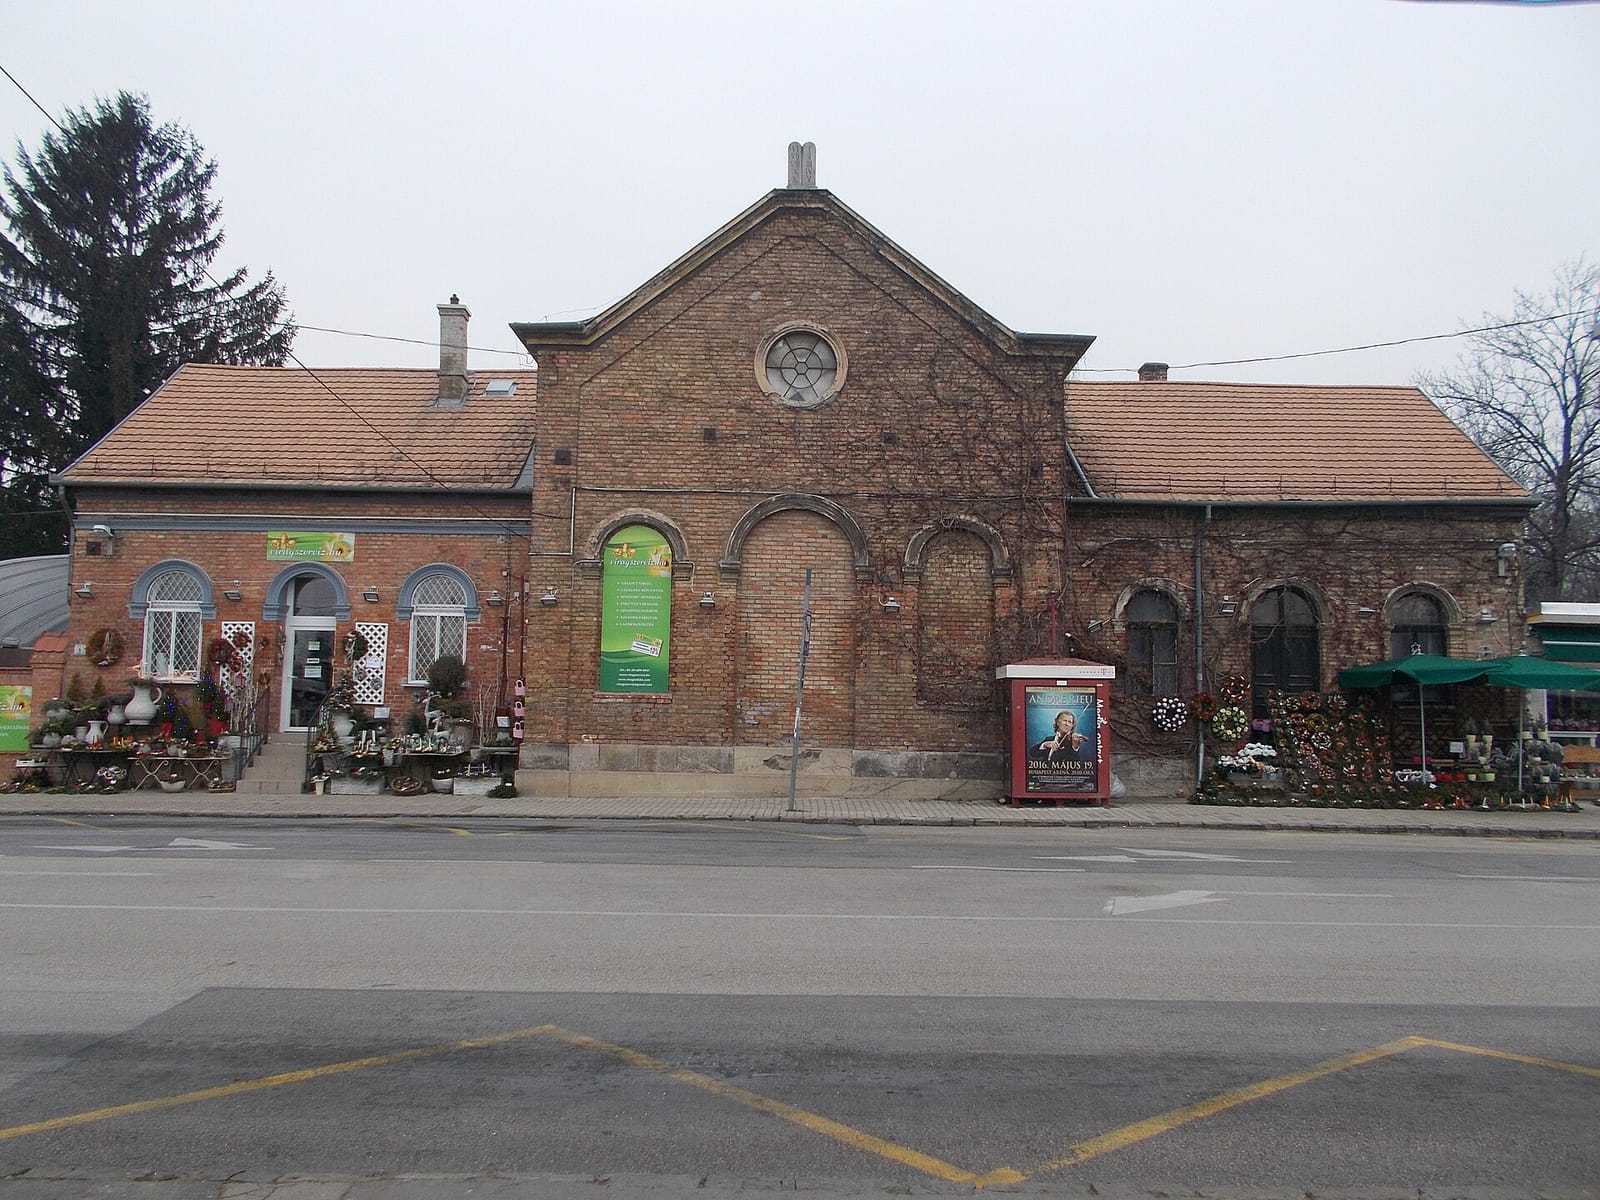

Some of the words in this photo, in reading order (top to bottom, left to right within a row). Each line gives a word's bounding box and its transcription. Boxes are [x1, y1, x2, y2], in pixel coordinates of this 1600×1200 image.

[1070, 694, 1093, 704] RIEU
[1028, 760, 1049, 769] 2016.
[1051, 759, 1081, 770] MÁJUS
[1084, 760, 1094, 770] 19.
